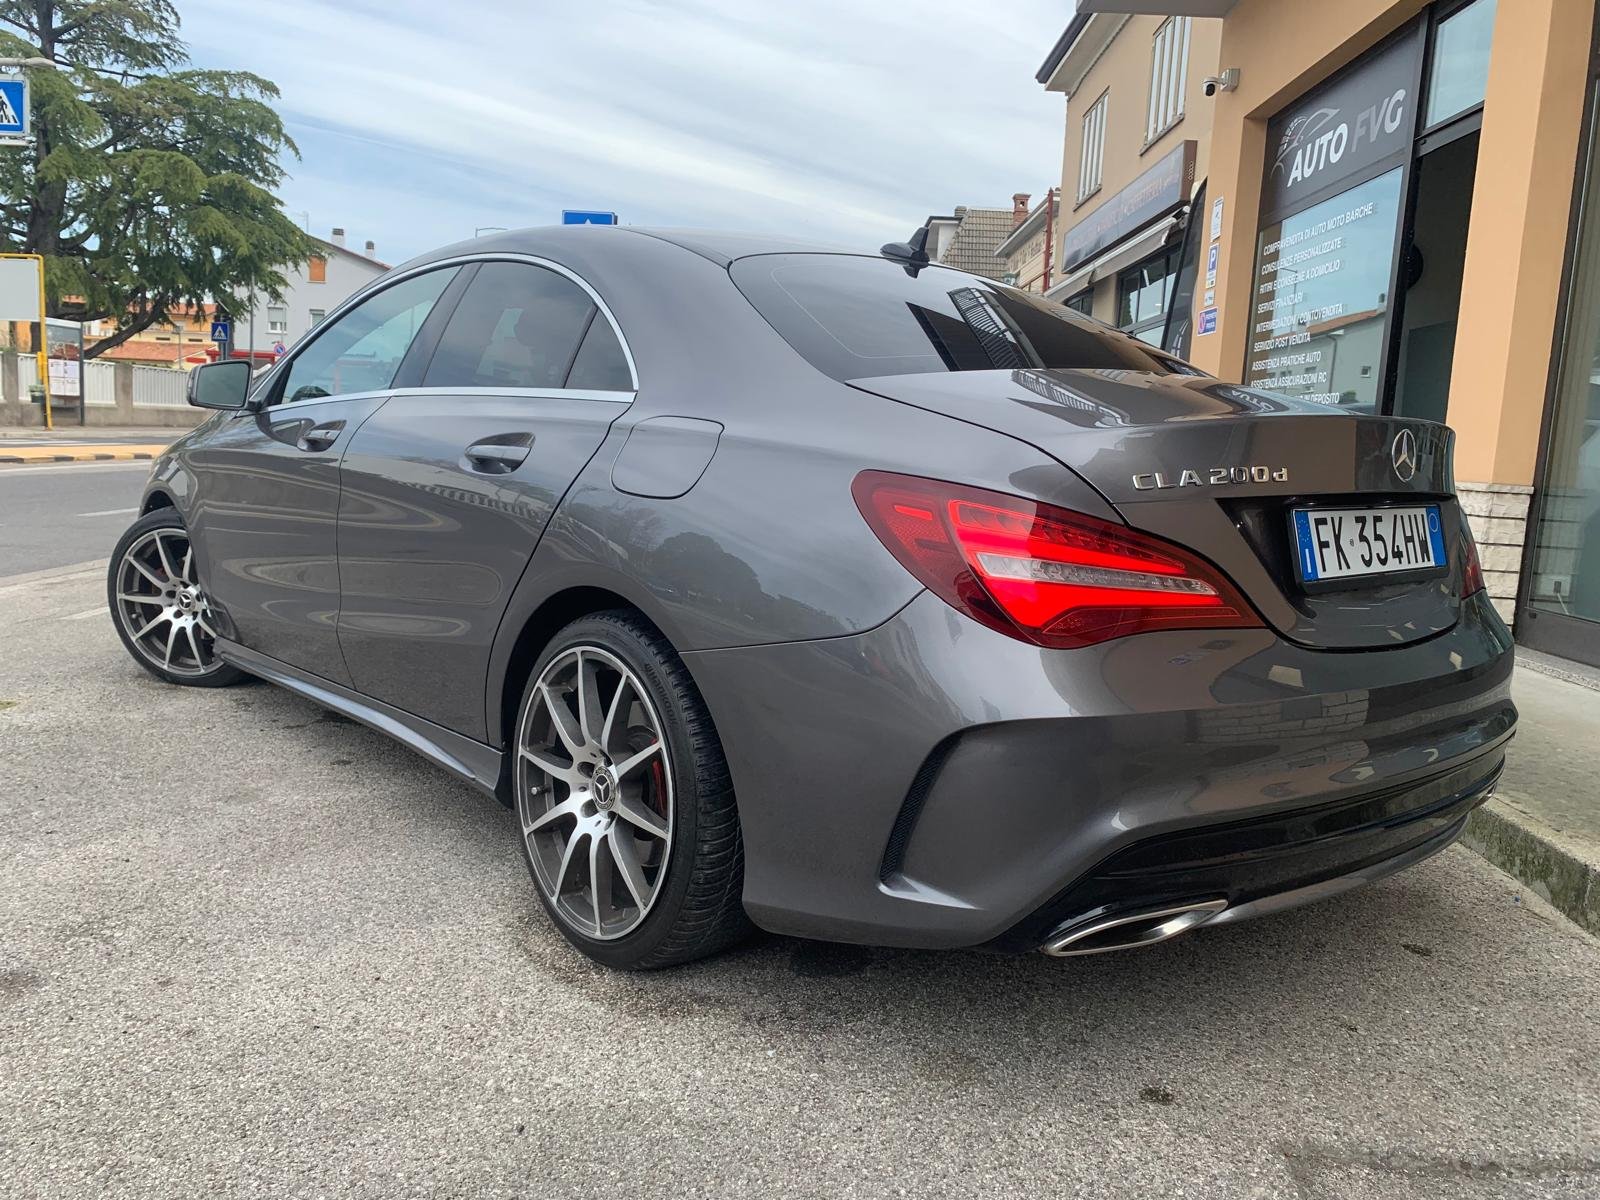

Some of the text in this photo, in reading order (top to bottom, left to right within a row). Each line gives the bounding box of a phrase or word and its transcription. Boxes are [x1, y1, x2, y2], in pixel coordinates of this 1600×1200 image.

[1286, 88, 1406, 188] AUTO FVG
[1263, 202, 1375, 256] COMPRAVENDITA DI AUTO MOTO BARCHE
[1261, 237, 1342, 275] CONSULENZE PERSONALIZZATE
[1259, 281, 1273, 294] RITIRI
[1277, 270, 1306, 290] CONSEGNE
[1310, 259, 1341, 279] DOMICILIO
[1299, 304, 1343, 324] CONTOVENDITA
[1254, 332, 1311, 352] SERVIZIO POST VENDITA
[1251, 351, 1322, 371] ASSISTENZA PRATICHE AUTO
[1250, 371, 1327, 389] ASSISTENZA ASSICURAZIONI RC
[1132, 465, 1289, 491] CLA 200d
[1313, 516, 1351, 573] FK
[1353, 512, 1432, 569] 354HW
